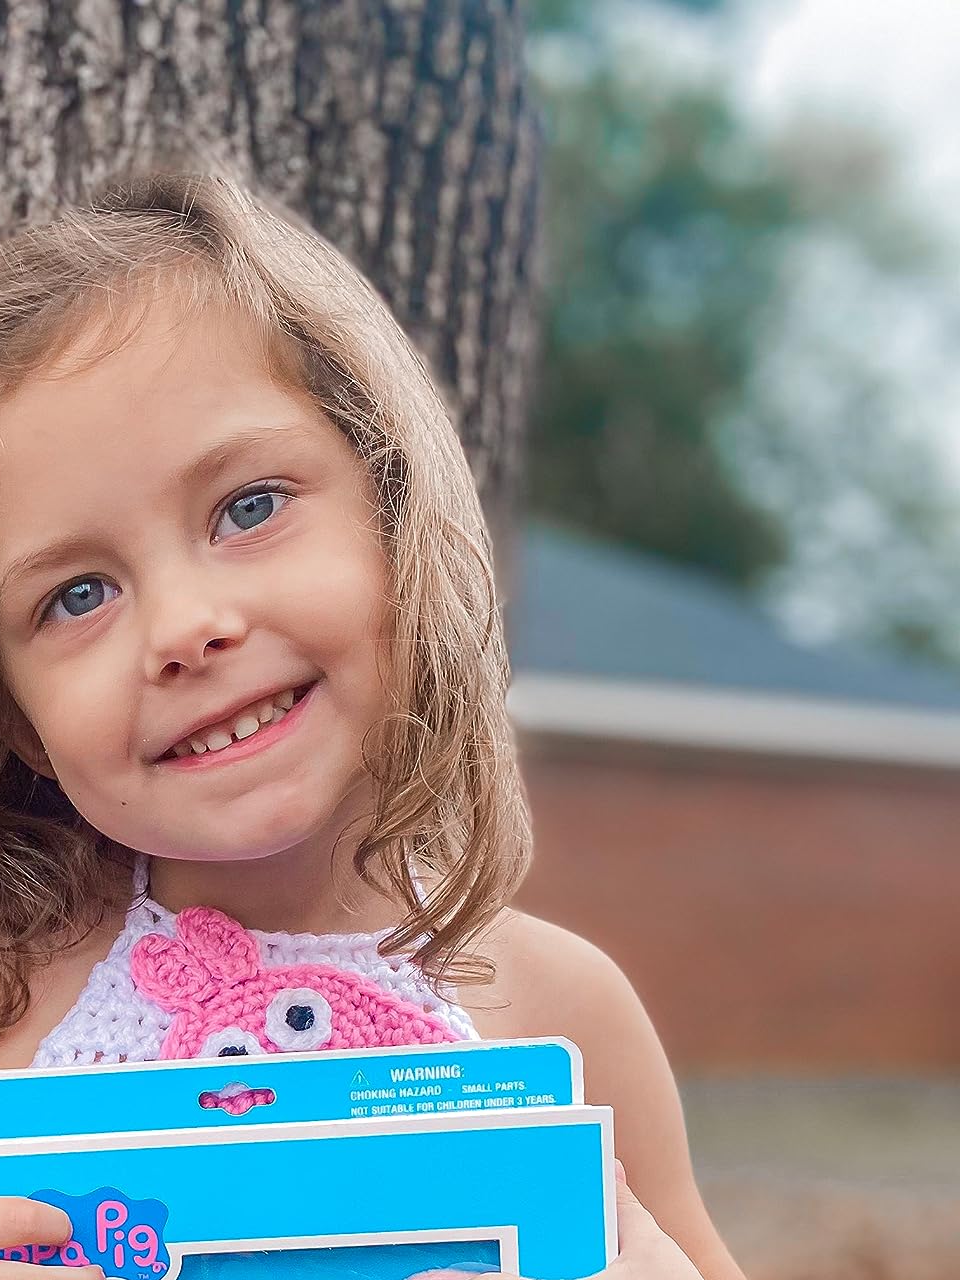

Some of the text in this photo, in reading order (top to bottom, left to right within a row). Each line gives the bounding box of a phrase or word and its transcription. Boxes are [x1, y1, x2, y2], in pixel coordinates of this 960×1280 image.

[390, 1064, 465, 1083] WARNING:
[350, 1088, 397, 1101] CHOKING
[399, 1085, 442, 1098] HAZARD
[461, 1083, 492, 1094] SMALL
[350, 1106, 368, 1117] NOT
[371, 1103, 414, 1115] SUITABLE
[416, 1101, 434, 1112] FOR
[436, 1098, 482, 1111] CHILDREN
[483, 1096, 514, 1108] UNDER
[517, 1096, 523, 1106] 3
[96, 1200, 167, 1273] Pig
[137, 1272, 150, 1280] TM
